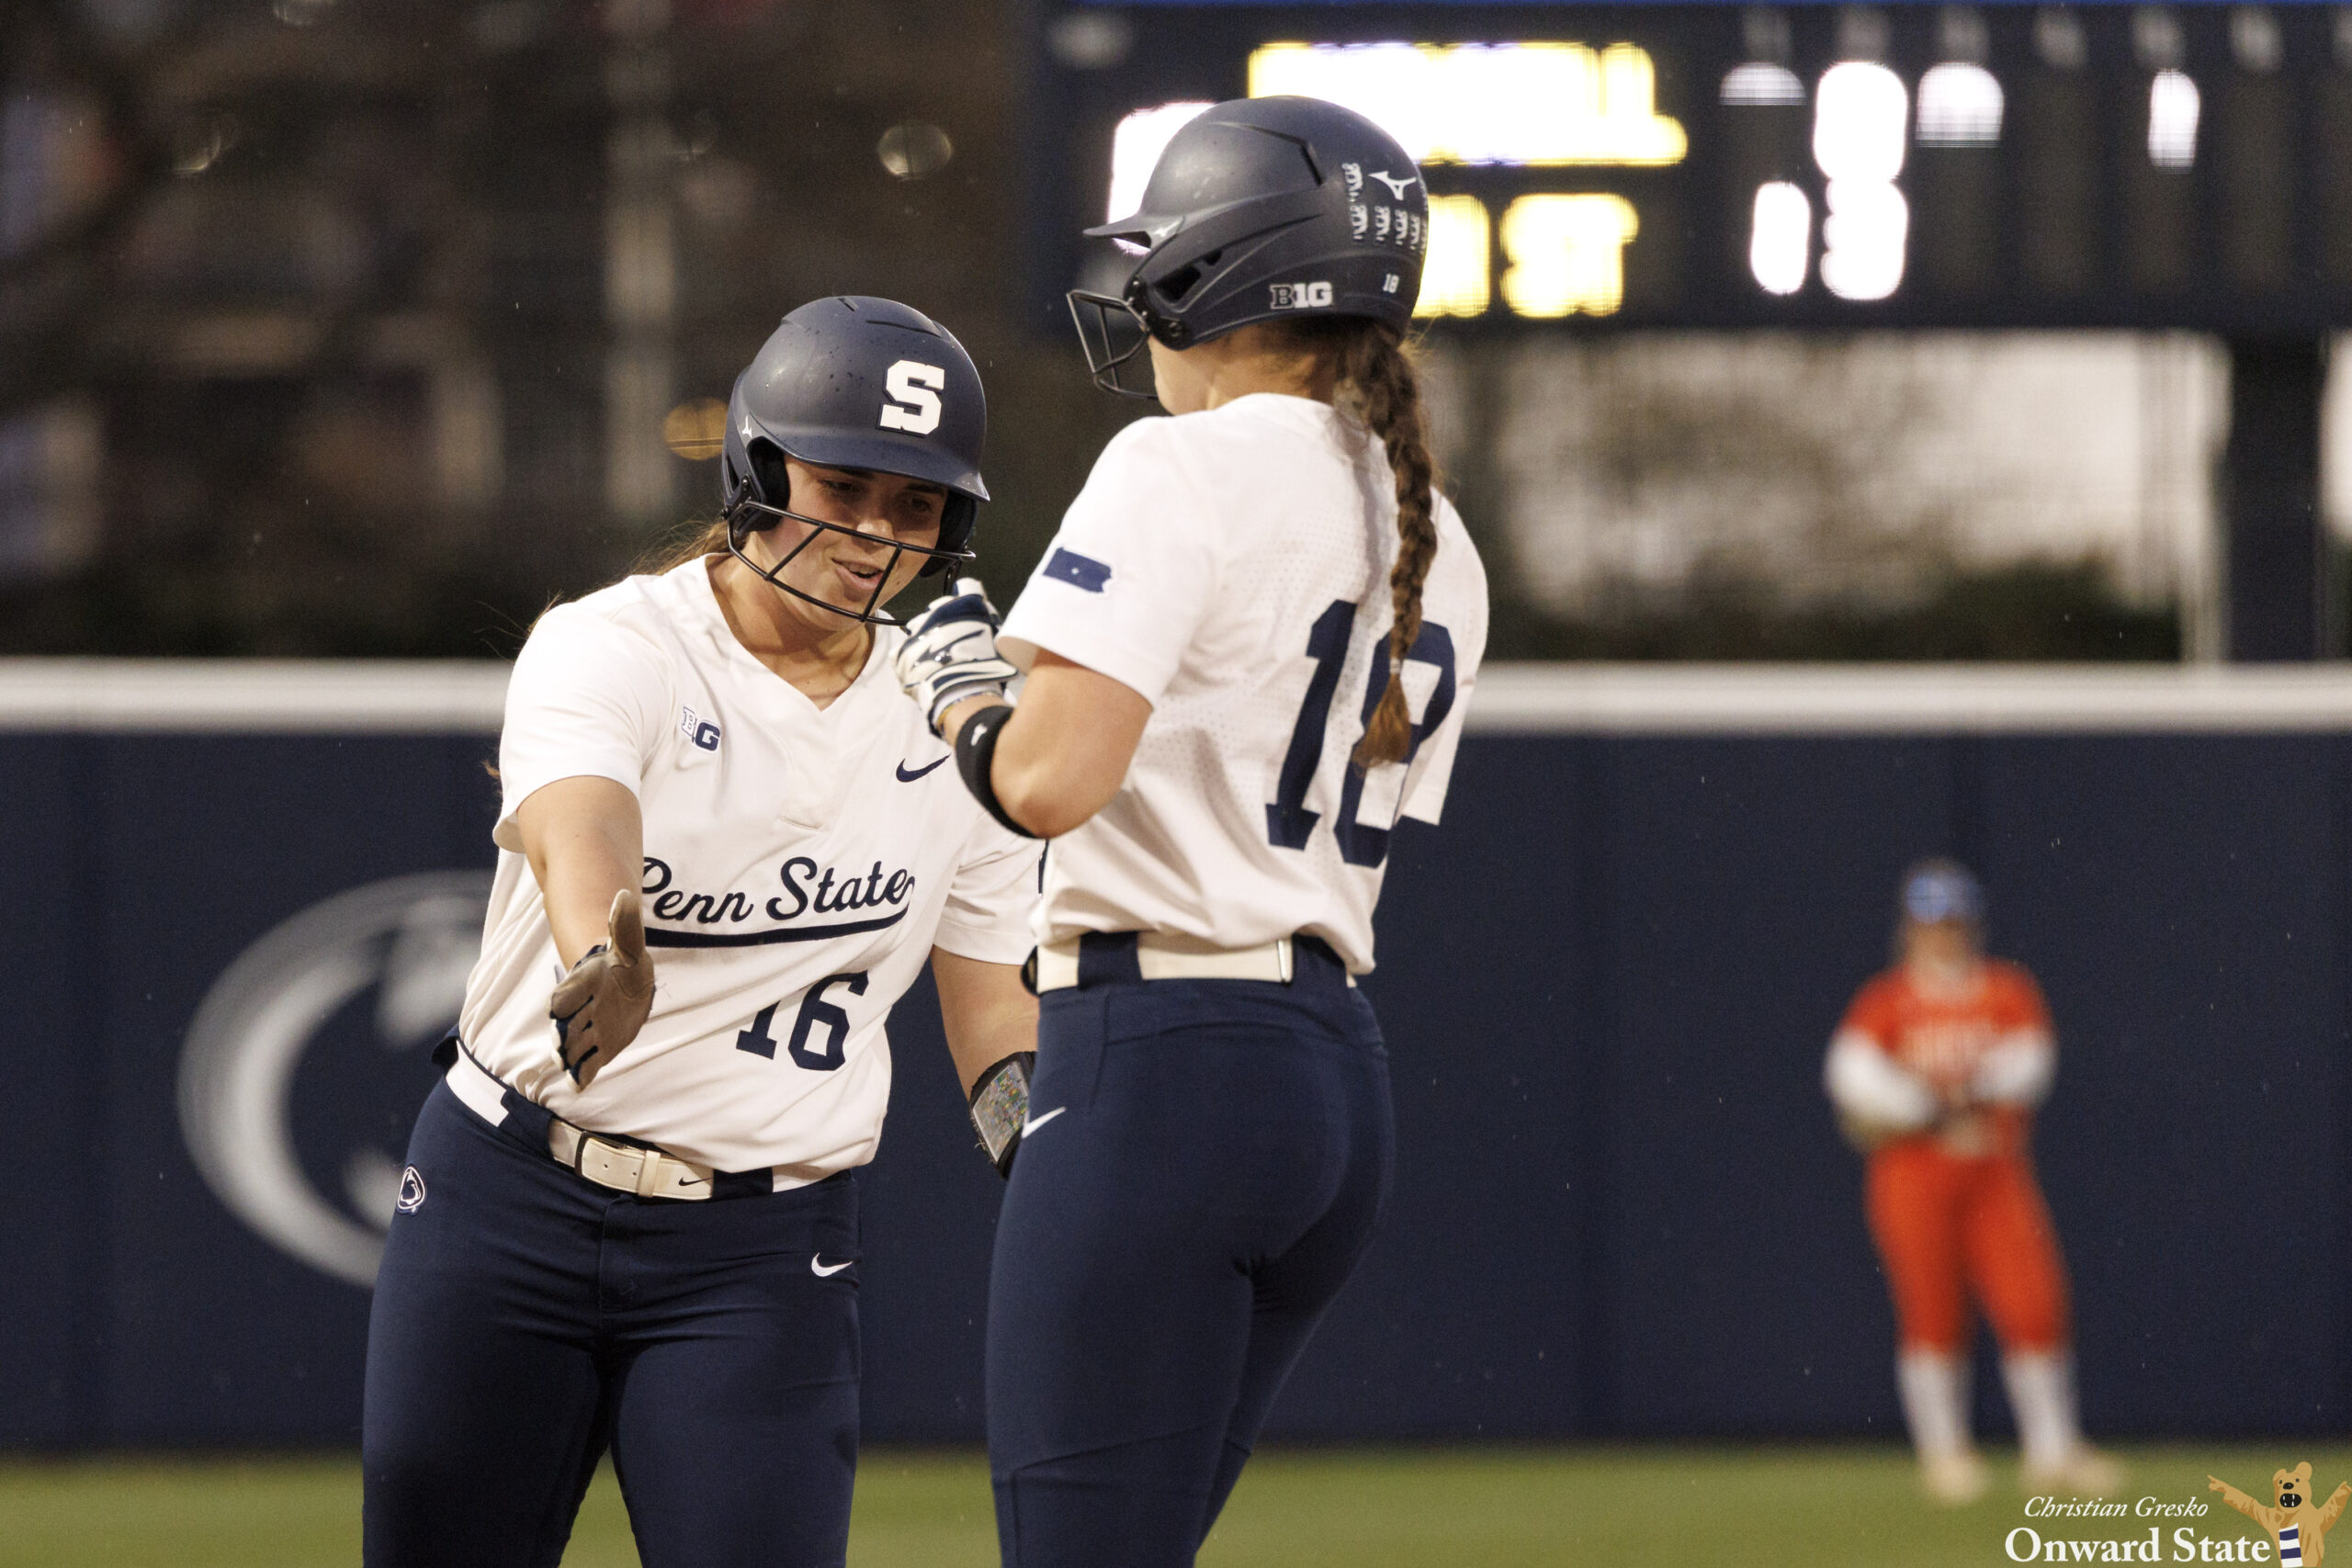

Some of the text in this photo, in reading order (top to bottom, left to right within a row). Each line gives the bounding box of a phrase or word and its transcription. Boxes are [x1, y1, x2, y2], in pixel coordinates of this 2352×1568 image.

[1383, 274, 1399, 294] 18
[879, 359, 945, 435] S
[1265, 599, 1456, 869] 18
[765, 856, 915, 920] State
[736, 970, 868, 1072] 16
